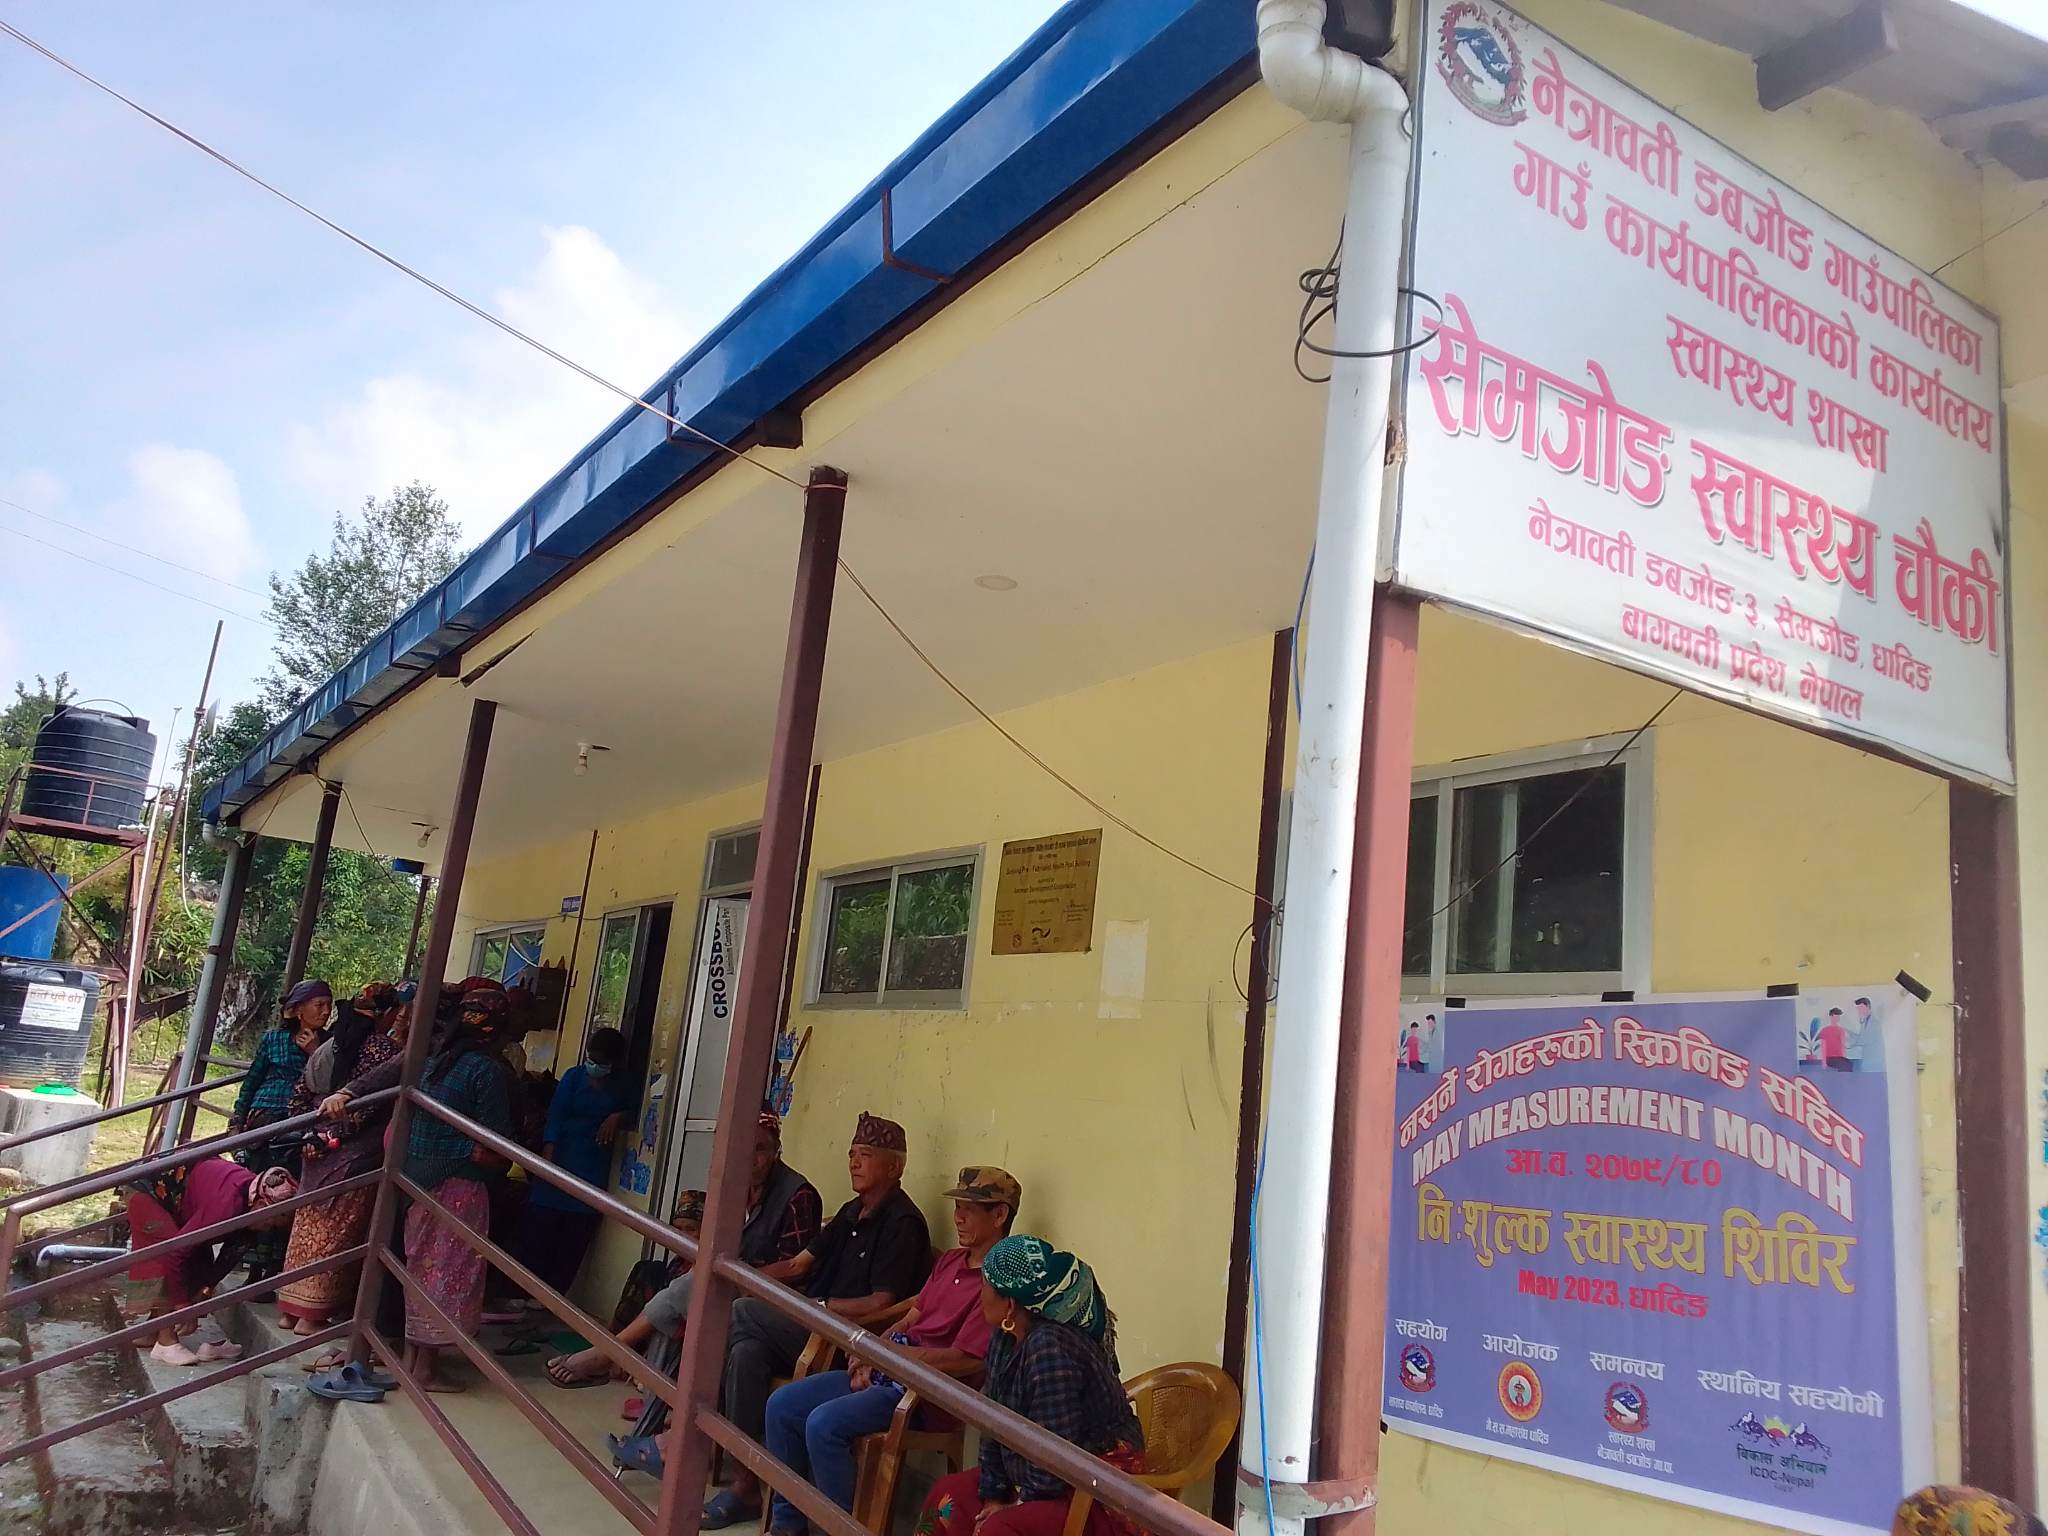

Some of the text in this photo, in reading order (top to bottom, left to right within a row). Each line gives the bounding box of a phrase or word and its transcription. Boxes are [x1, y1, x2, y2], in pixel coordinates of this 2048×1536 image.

[1532, 48, 1983, 375] नेत्रावती डबजोङ गाउँपालिका
[1513, 140, 1992, 453] गाउँ कार्यपालिकाको कार्यालय
[1666, 313, 1889, 474] स्वास्थ्य शाखा
[1420, 293, 2001, 656] सेमजोङ स्वास्थ्य चौकी
[1529, 497, 1637, 578] नेत्रावती
[1621, 602, 1720, 671] बागमती
[1799, 662, 1865, 720] नेपाल
[709, 905, 728, 1018] CROSSBO
[1400, 1064, 1458, 1148] नसर्ने
[1613, 1017, 1749, 1089] स्क्रिनिङ
[1761, 1065, 1865, 1169] सहित
[1411, 1086, 1853, 1224] MAY MEASUREMENT MONTH
[1518, 1269, 1560, 1302] May
[1563, 1210, 1708, 1276] स्वास्थ्य
[1722, 1207, 1857, 1294] शिविर
[1395, 1318, 1448, 1342] सहयोग
[1482, 1334, 1560, 1362] आयोजक
[1590, 1351, 1665, 1381] समन्वय
[1697, 1369, 1885, 1418] स्थानिय सहयोगी
